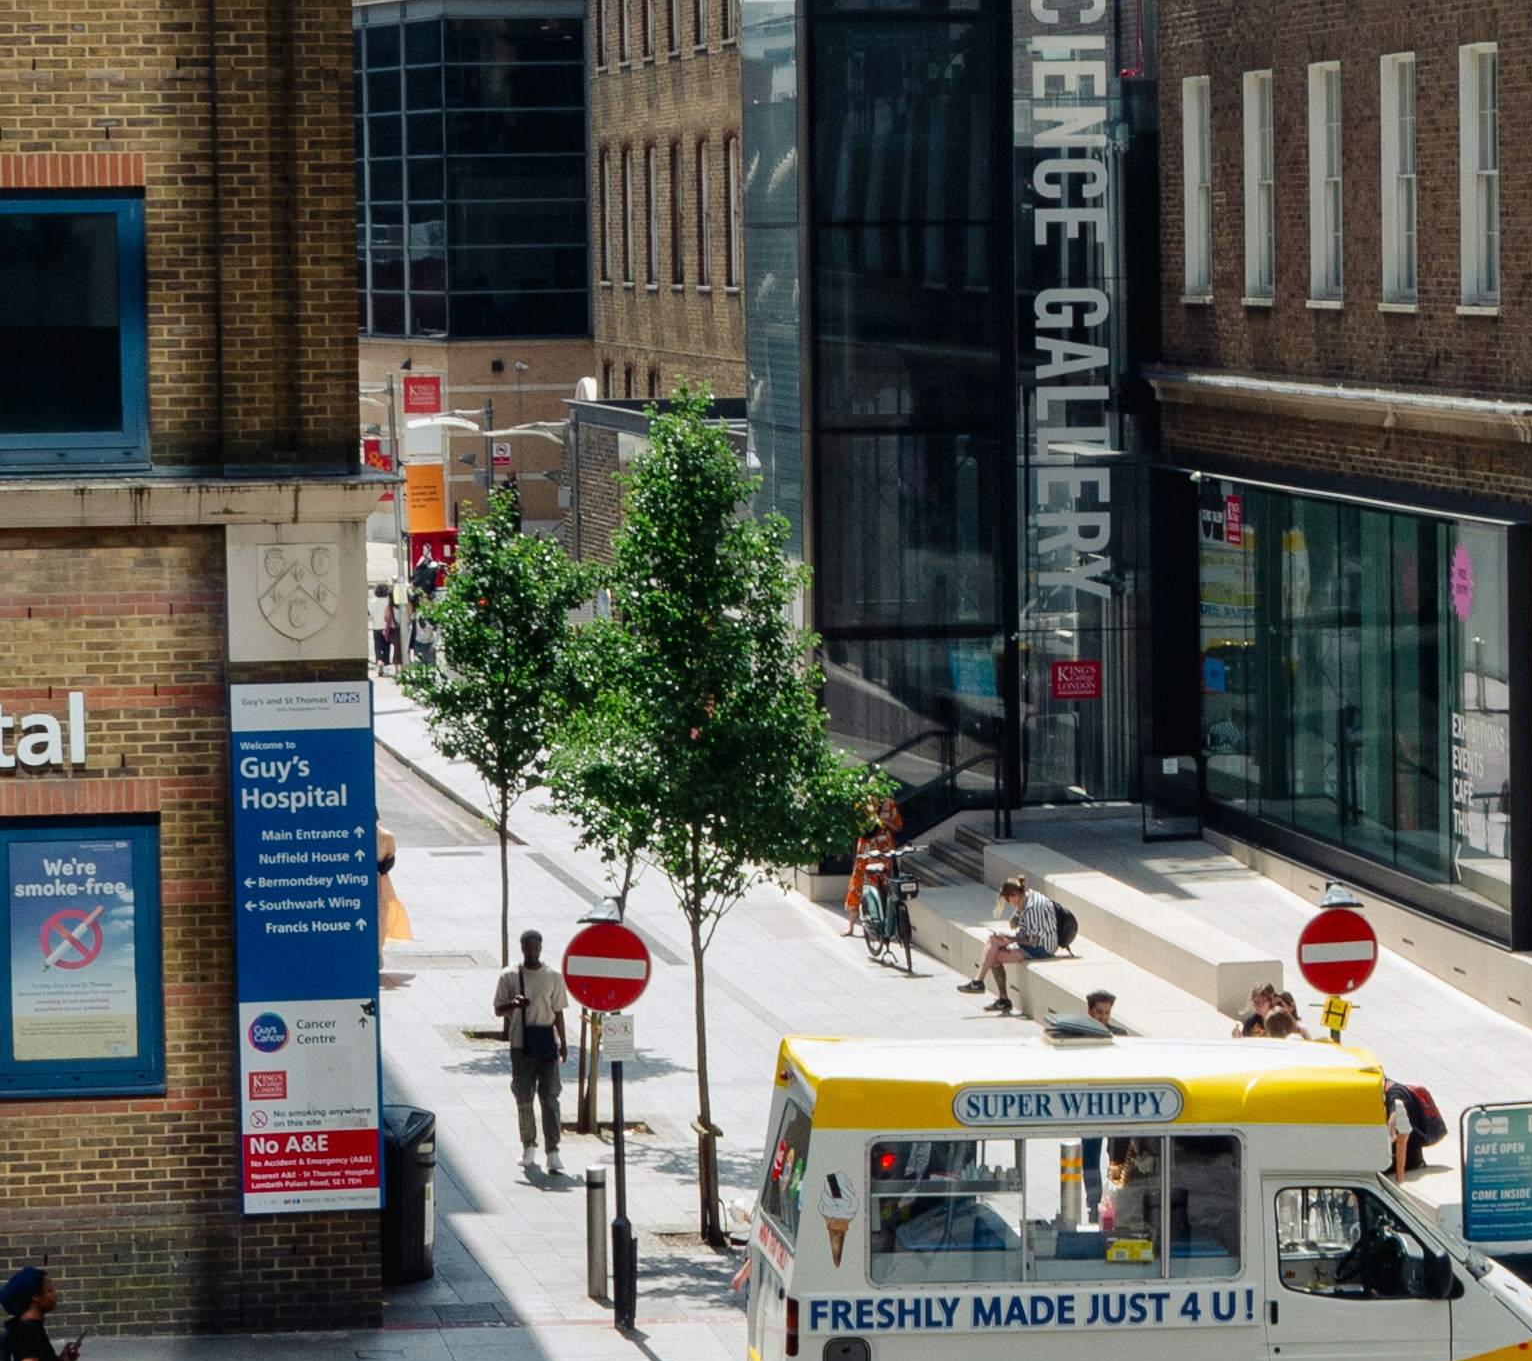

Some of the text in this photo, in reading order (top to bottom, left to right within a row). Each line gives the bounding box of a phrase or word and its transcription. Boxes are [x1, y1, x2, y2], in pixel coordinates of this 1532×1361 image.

[1033, 288, 1112, 599] GALLERY
[1057, 666, 1096, 682] KING'S
[1058, 682, 1096, 690] LONDON
[242, 698, 264, 706] Guy's
[295, 696, 330, 704] Thomas'
[334, 692, 360, 703] NHS
[1452, 712, 1505, 752] EXHIBITIONS
[240, 740, 296, 750] Welcome to
[1452, 744, 1484, 778] EVENTS
[240, 756, 310, 783] Guy's
[242, 784, 347, 813] Hospital
[1453, 777, 1474, 807] CAFÉ
[262, 829, 349, 841] Main Entrance
[258, 852, 350, 864] Nuffield House
[43, 857, 97, 876] We're
[258, 872, 369, 888] Bermondsey Wing
[14, 877, 127, 898] smoke-free
[258, 897, 361, 911] Southwark Wing
[266, 921, 351, 934] Francis House
[296, 1019, 337, 1029] Cancer
[254, 1034, 285, 1042] Cancer
[296, 1034, 336, 1044] Centre
[966, 1091, 1166, 1118] SUPER WHIPPY
[274, 1107, 372, 1118] No smoking anywhere
[250, 1134, 328, 1154] No A&E
[1474, 1142, 1526, 1155] CAFÉ OPEN
[251, 1155, 372, 1168] No Accident & Emergency (A&E)
[251, 1172, 280, 1180] Nearest
[280, 1172, 296, 1180] A&E
[302, 1170, 311, 1178] St
[312, 1170, 343, 1178] Thomas'
[344, 1168, 375, 1176] Hospital
[251, 1181, 284, 1190] Lambeth
[285, 1180, 308, 1188] Palace
[310, 1179, 330, 1187] Road,
[332, 1178, 346, 1186] SE1
[1472, 1188, 1532, 1201] COME INSIDE
[810, 1297, 960, 1332] FRESHLY
[972, 1294, 1076, 1329] MADE
[1086, 1293, 1170, 1326] JUST
[1180, 1290, 1201, 1322] 4
